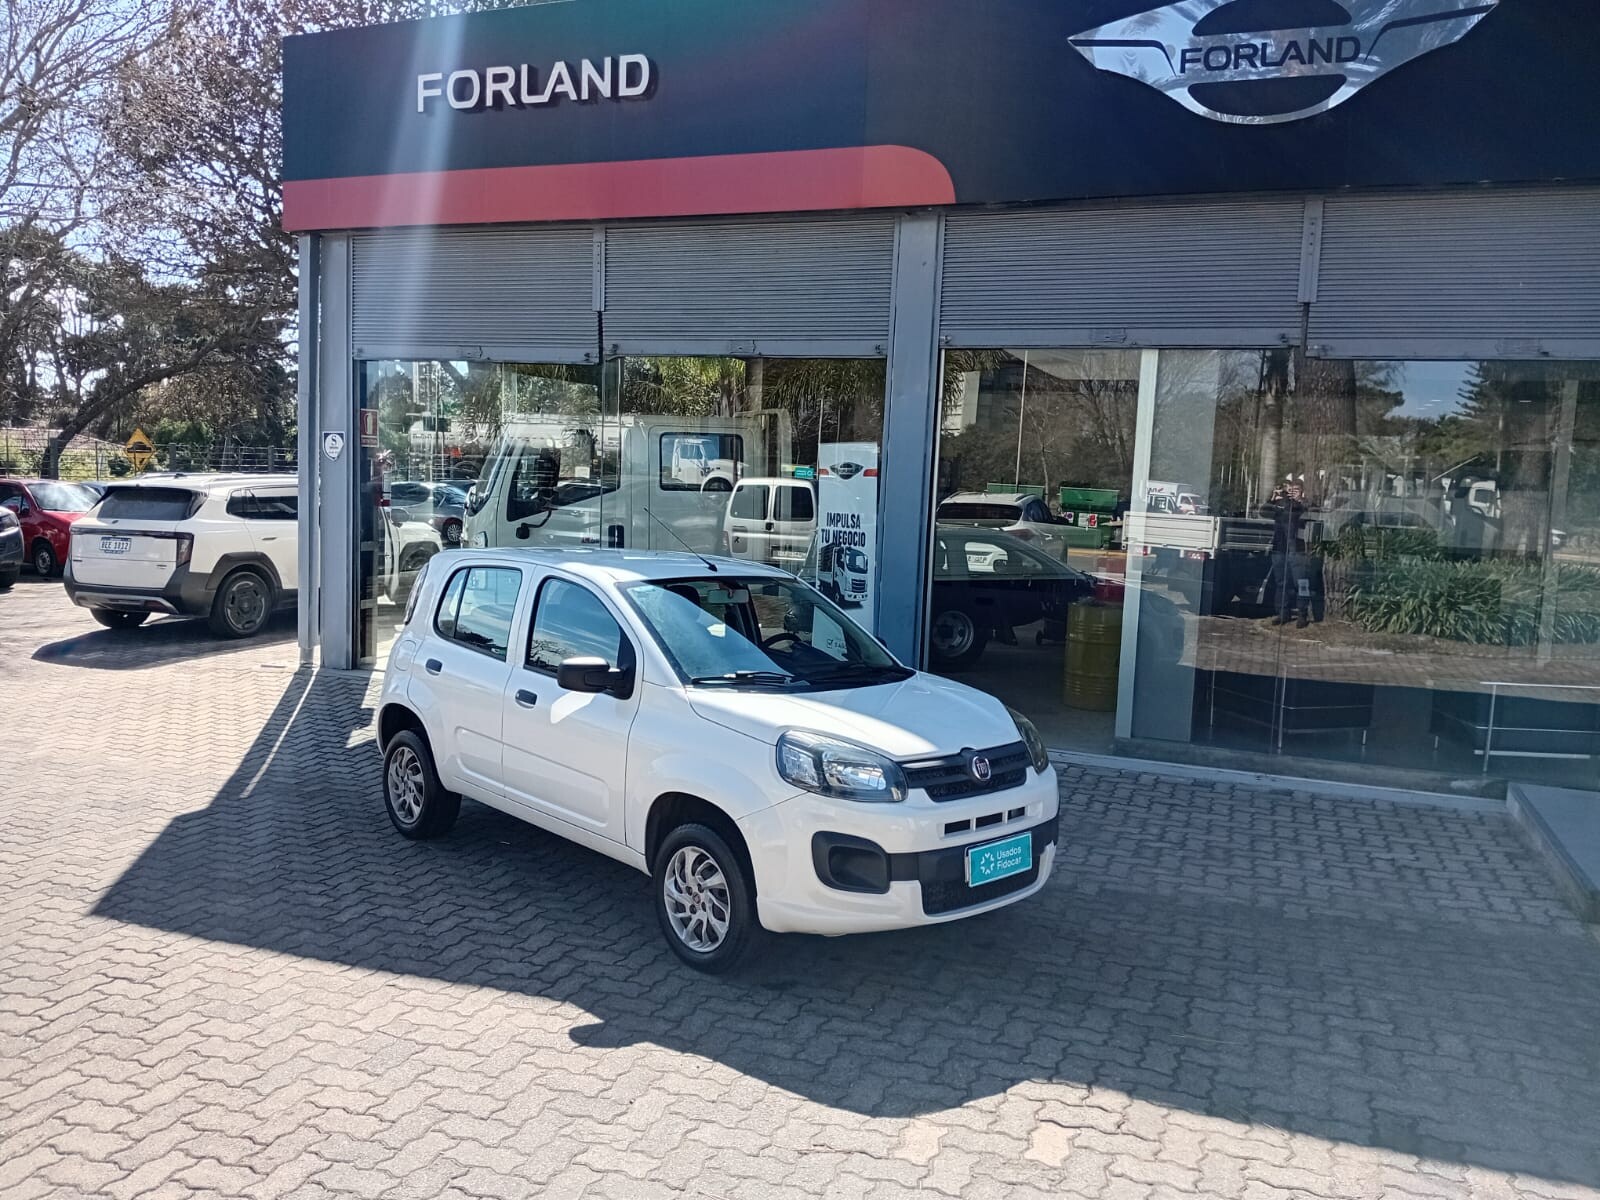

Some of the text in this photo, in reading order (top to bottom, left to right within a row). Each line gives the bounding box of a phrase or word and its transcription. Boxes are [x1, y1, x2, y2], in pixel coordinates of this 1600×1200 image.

[1180, 36, 1361, 74] FORLAND
[417, 53, 651, 113] FORLAND
[826, 512, 860, 529] IMPULSA
[821, 528, 866, 547] TU NEGOCIO
[997, 846, 1021, 859] Usados
[997, 857, 1021, 870] Fidocar
